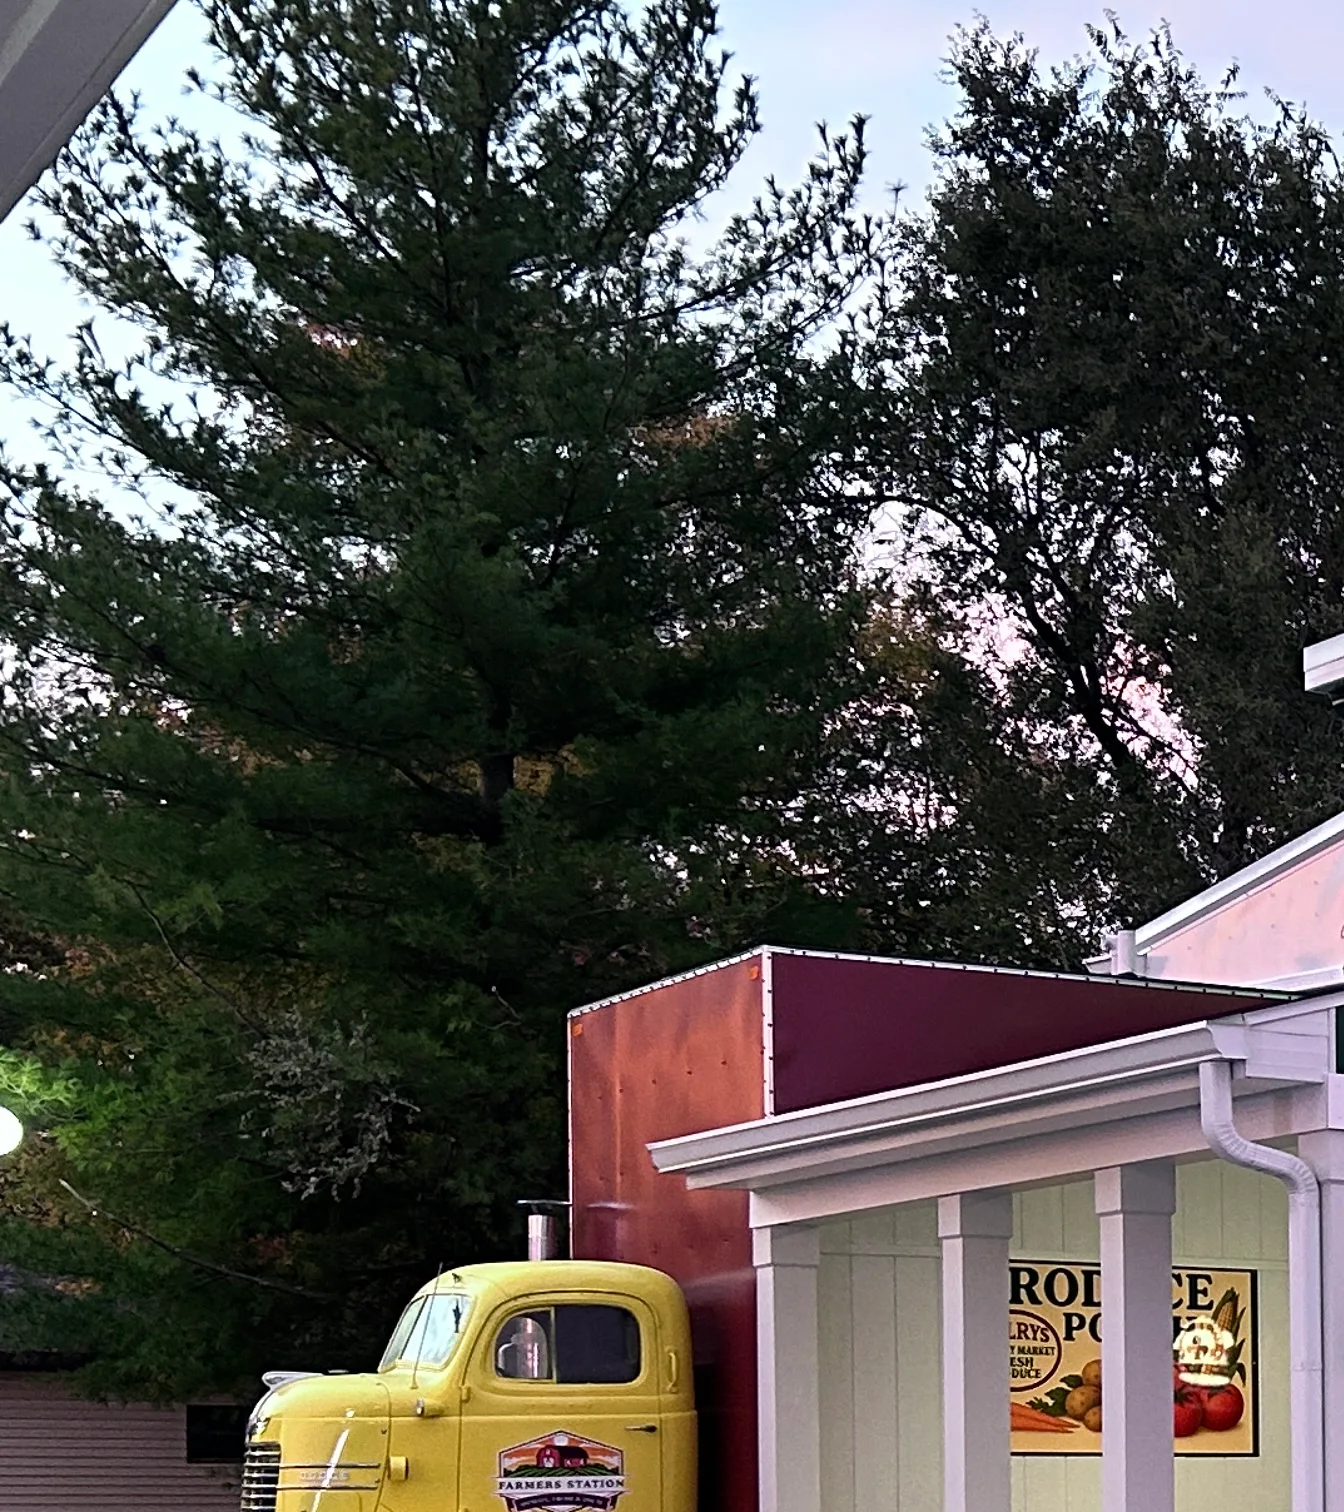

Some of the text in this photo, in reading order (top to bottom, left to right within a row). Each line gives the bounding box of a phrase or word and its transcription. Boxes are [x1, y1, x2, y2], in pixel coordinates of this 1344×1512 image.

[1009, 1321, 1050, 1342] LRYS
[1017, 1345, 1056, 1356] MARKET
[499, 1479, 625, 1490] FARMERS STATION
